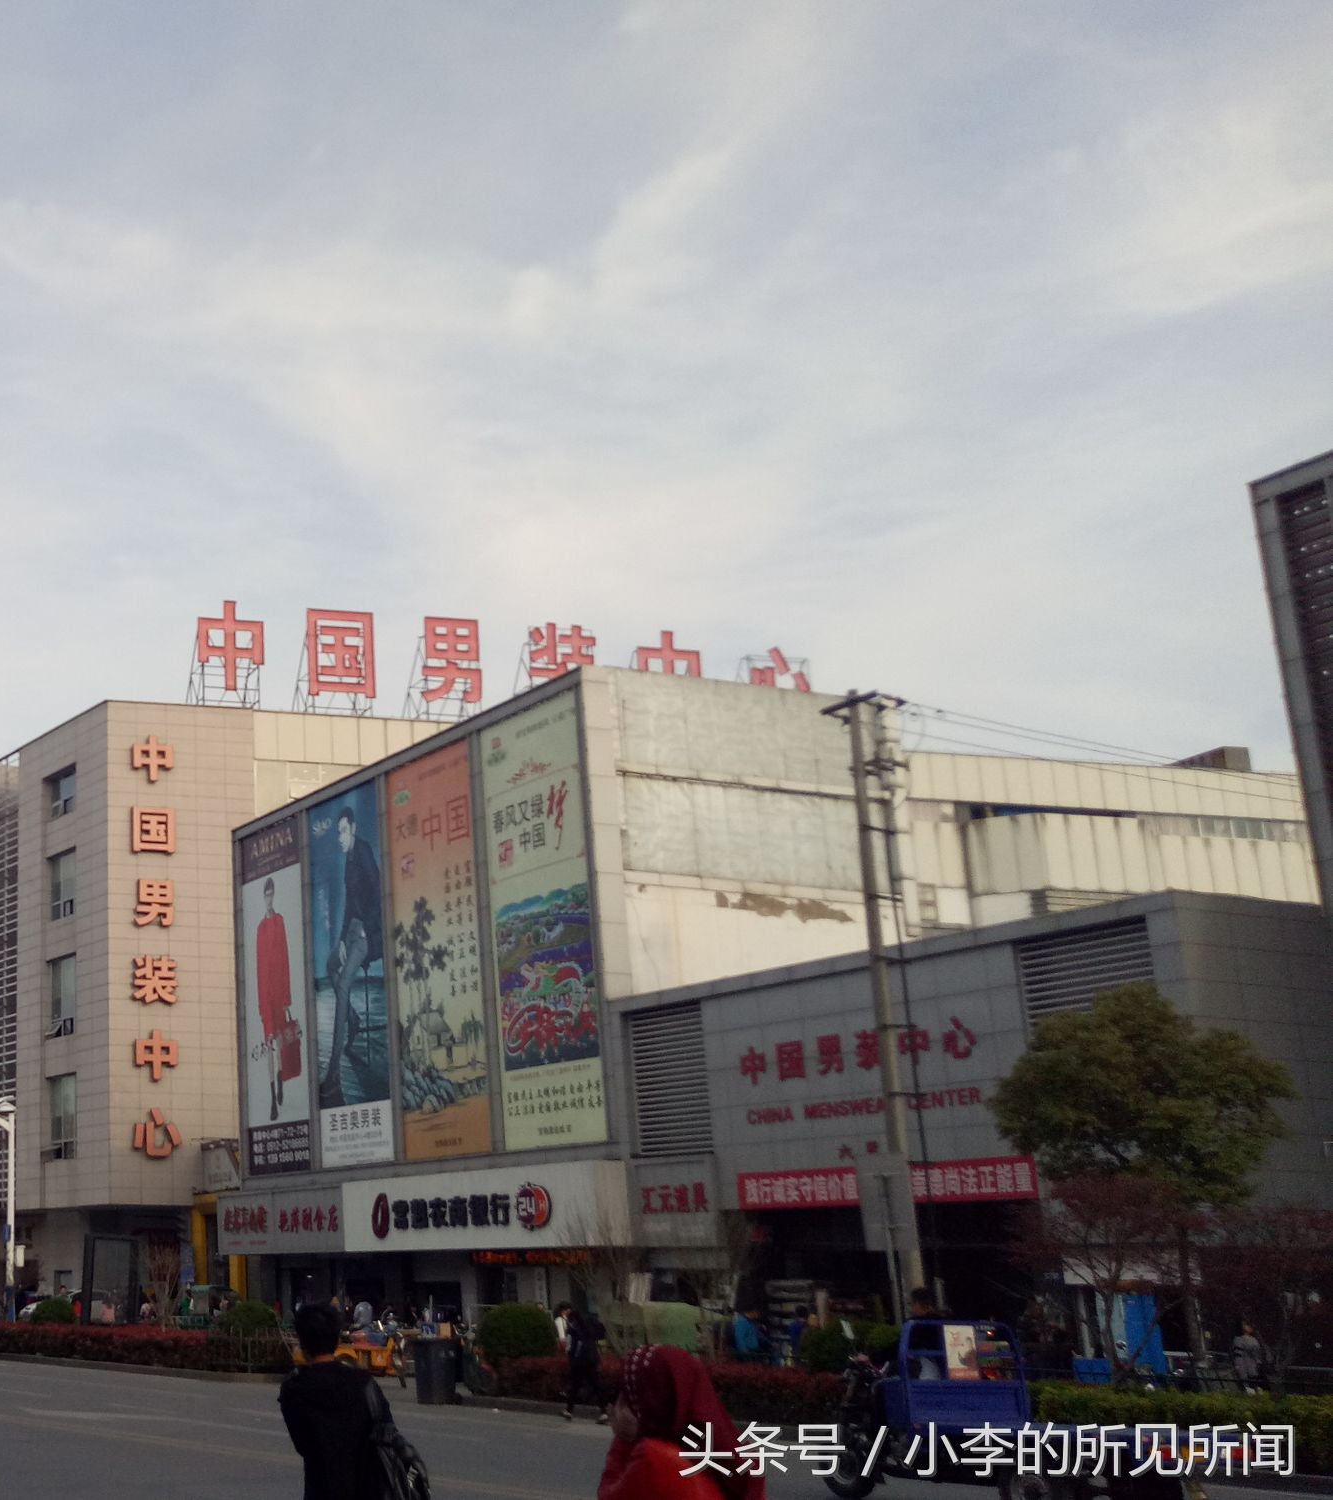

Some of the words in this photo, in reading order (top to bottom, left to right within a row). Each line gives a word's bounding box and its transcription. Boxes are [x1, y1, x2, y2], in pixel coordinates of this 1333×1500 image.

[131, 735, 181, 1160] 中国男装中心
[740, 1015, 978, 1087] 中国男装中心
[747, 1104, 794, 1125] CHINA
[804, 1098, 887, 1120] MENSWEA
[907, 1087, 982, 1111] CENTER
